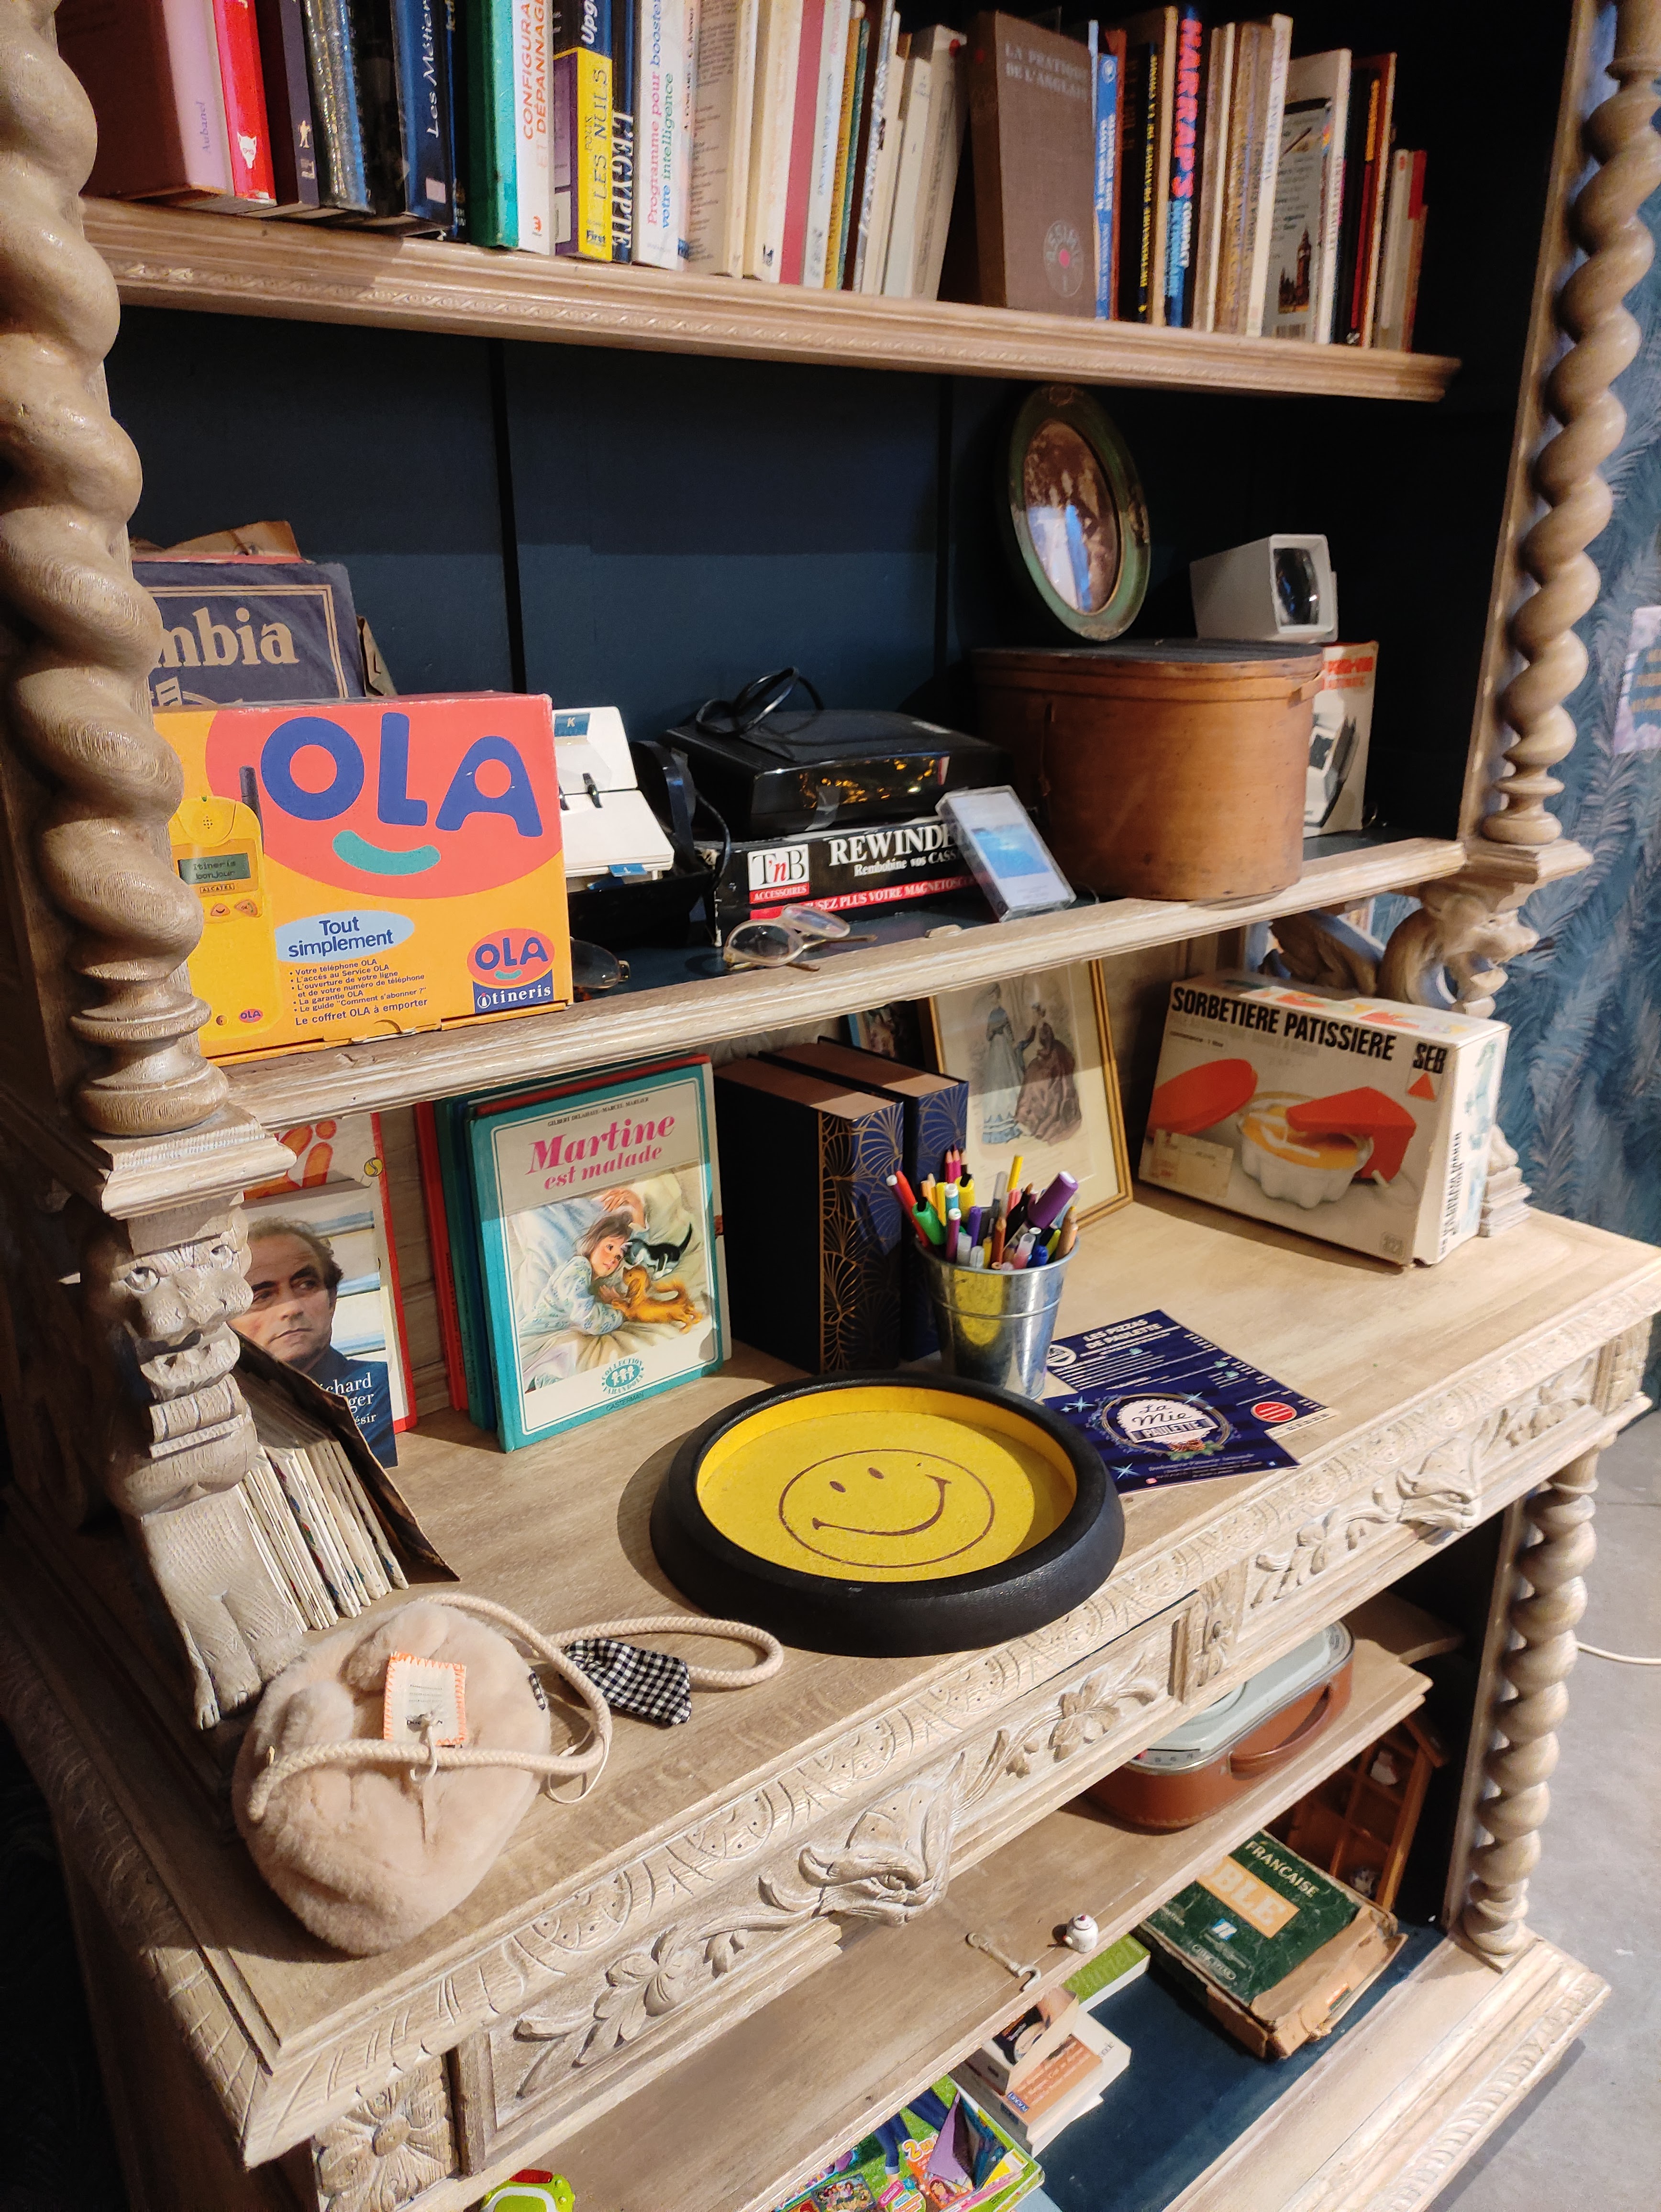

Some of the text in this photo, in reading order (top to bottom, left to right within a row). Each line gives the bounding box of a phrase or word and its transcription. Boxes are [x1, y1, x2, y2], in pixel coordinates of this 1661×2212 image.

[580, 0, 598, 45] Upg
[427, 91, 439, 138] Les
[646, 0, 663, 225] Programme pour booste
[593, 68, 608, 200] LES NULS
[660, 73, 674, 229] votre intelligence
[156, 607, 300, 668] mbia
[260, 712, 543, 838] OLA
[829, 822, 961, 867] REWINDE
[854, 850, 957, 877] Rembobine vos CASS
[753, 885, 807, 901] ACCESSOIRES
[839, 893, 867, 908] PLUS
[869, 888, 902, 903] VOTRE
[319, 917, 360, 936] Tout
[288, 929, 394, 957] simplement
[475, 937, 549, 971] OLA
[295, 967, 317, 975] Votre
[320, 962, 358, 973] téléphone
[342, 967, 371, 977] Service
[298, 979, 343, 991] L'ouverture
[380, 971, 399, 980] ligne
[321, 986, 341, 995] votre
[343, 981, 374, 991] numéro
[388, 973, 425, 985] téléphone
[312, 993, 345, 1005] garantie
[347, 990, 364, 998] OLA
[312, 1002, 334, 1012] guide
[380, 989, 417, 1000] s'abonner
[240, 1009, 261, 1019] OLA
[295, 998, 428, 1026] Le coffret OLA à emporter
[1172, 986, 1280, 1034] SORBETIERE
[1284, 1012, 1396, 1062] PATISSIERE
[1413, 1042, 1447, 1075] SEB
[548, 1116, 570, 1127] GILBERT
[602, 1104, 624, 1113] MARCEL
[525, 1112, 675, 1175] Martine
[544, 1145, 663, 1190] est malade
[1083, 1319, 1148, 1342] LES PIZZAS
[1085, 1323, 1163, 1349] DE PAULETTE
[319, 1371, 373, 1395] chard
[348, 1393, 375, 1414] ger
[606, 1391, 644, 1411] CASTERMAN
[355, 1412, 377, 1426] ésir
[1132, 1410, 1193, 1427] Mie
[1142, 1420, 1203, 1438] PAULETTE
[1210, 1863, 1288, 1926] BLE
